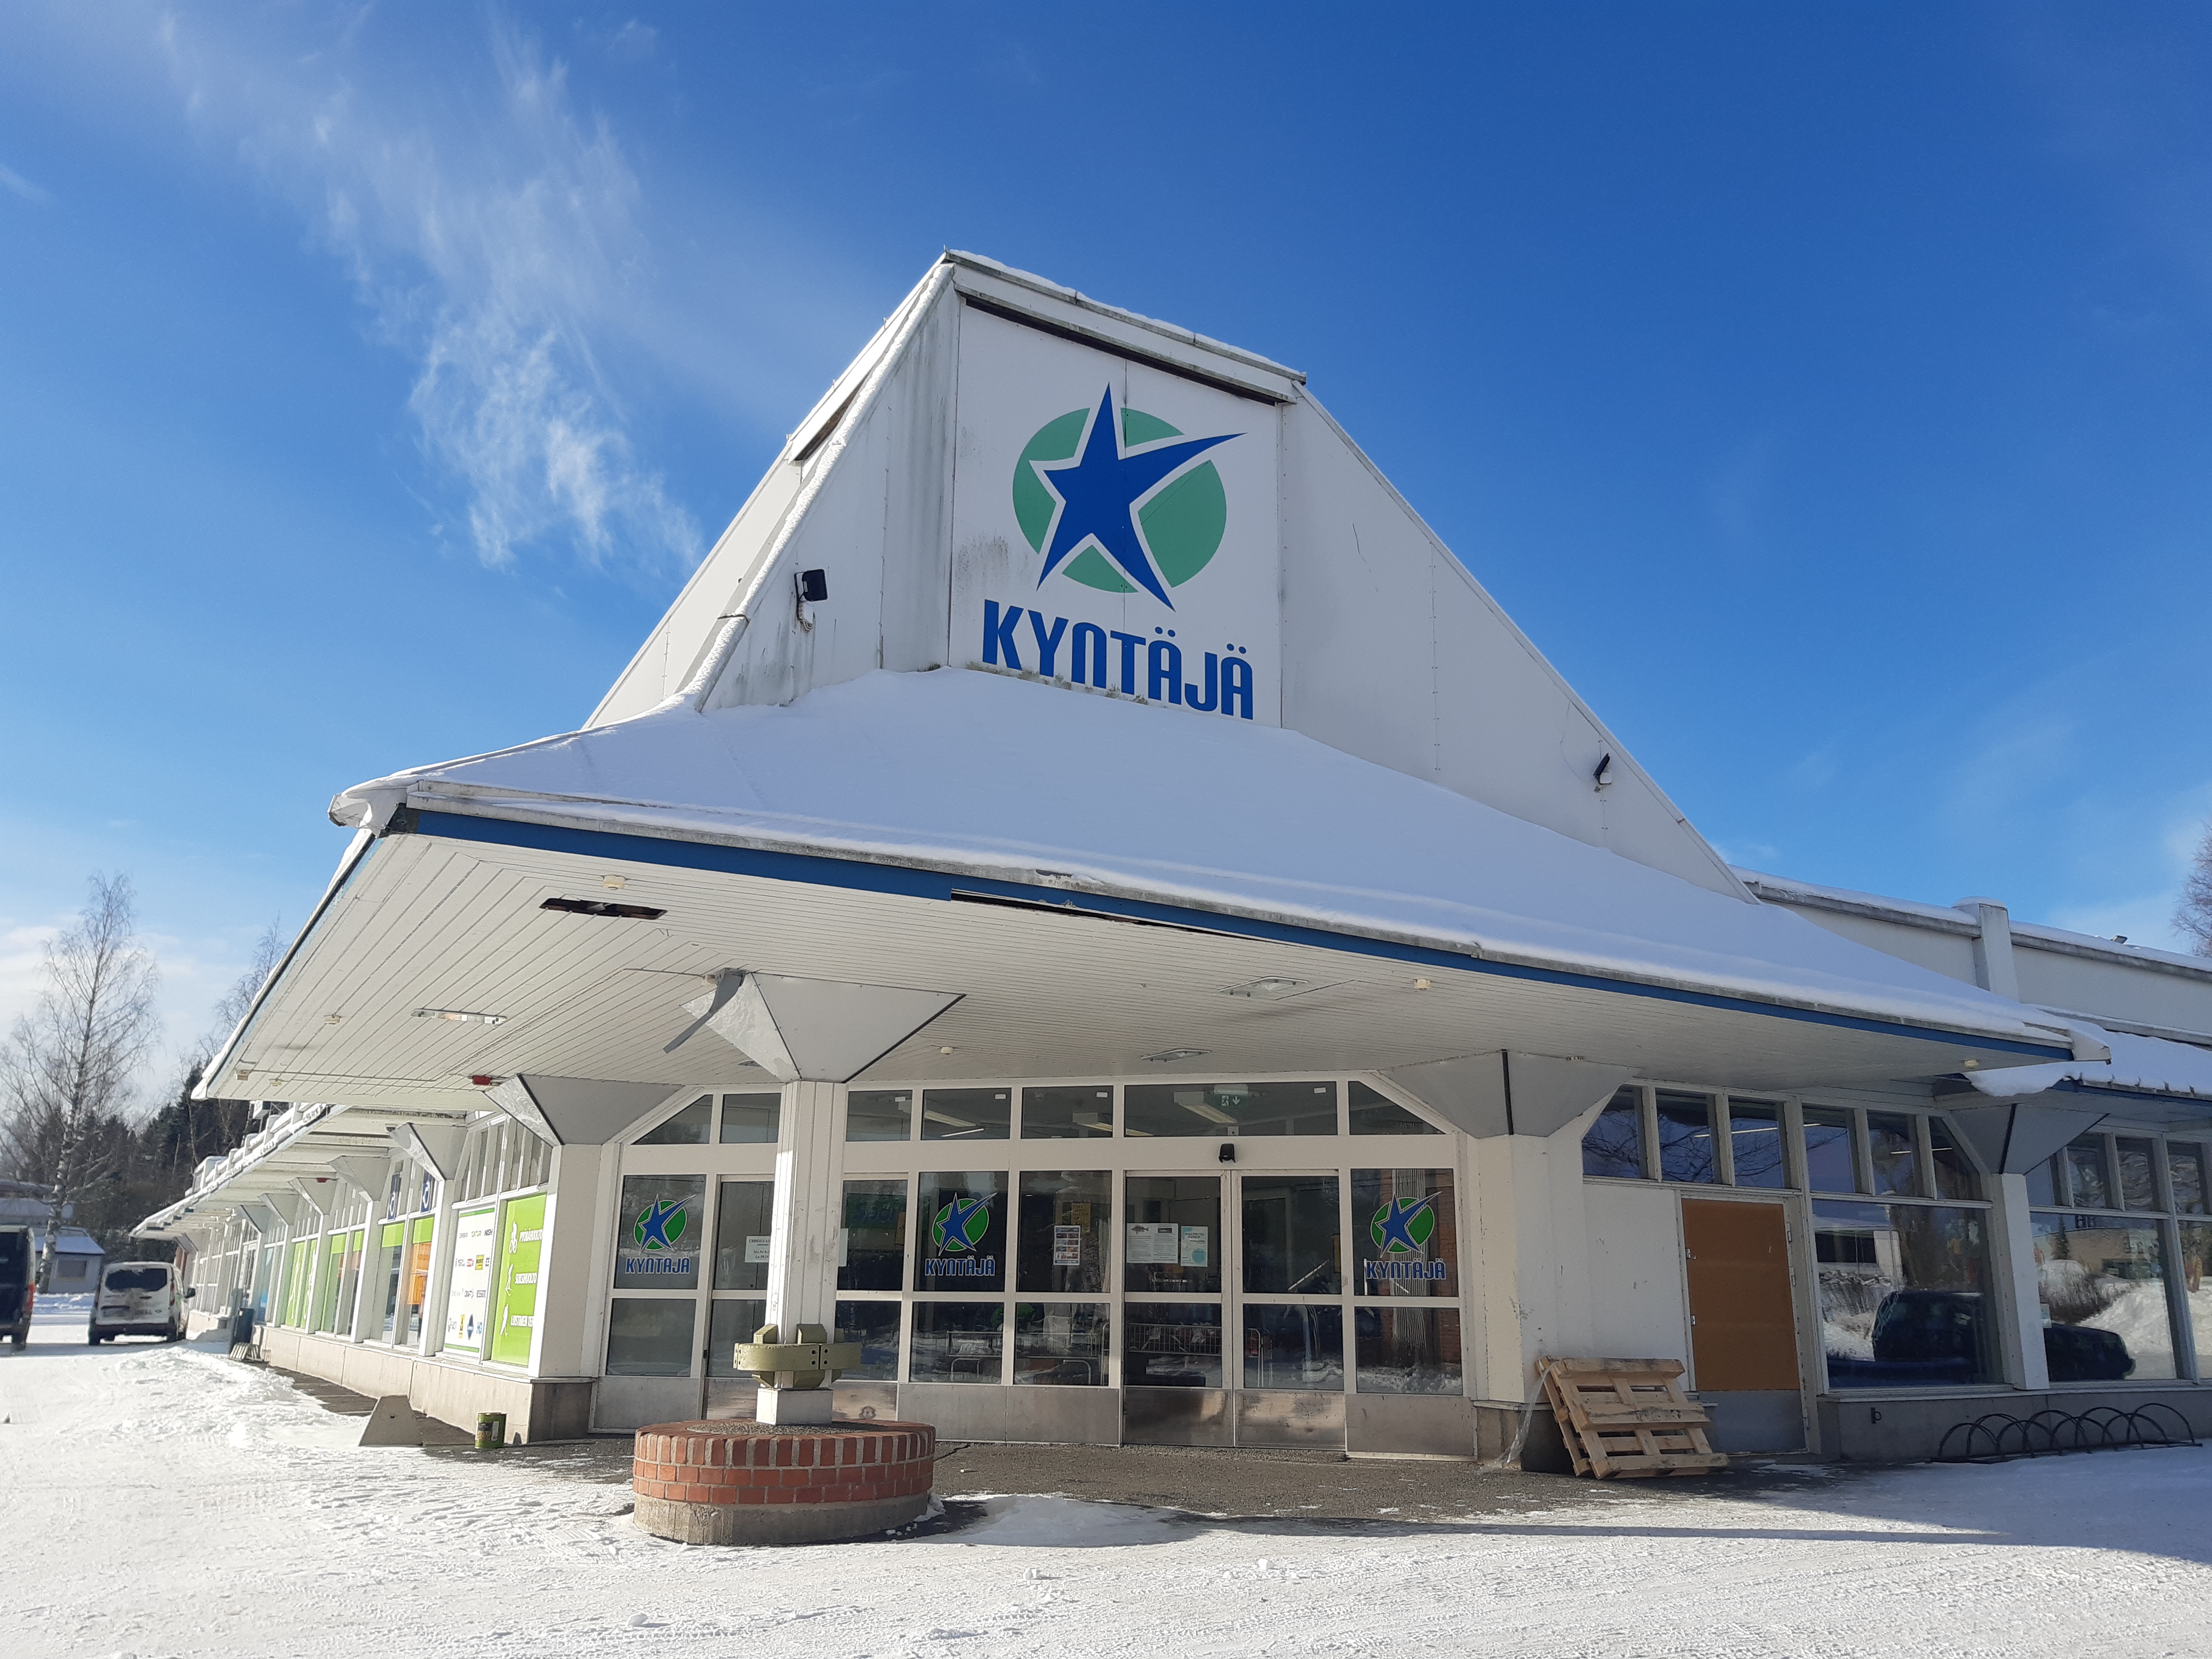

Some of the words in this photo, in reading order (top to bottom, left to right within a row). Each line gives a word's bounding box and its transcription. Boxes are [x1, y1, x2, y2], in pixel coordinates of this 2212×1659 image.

[982, 599, 1253, 720] KYNTÄJÄ
[519, 1227, 543, 1242] PYÖRÄHUOLTO
[625, 1254, 690, 1274] KYNTÄJÄ
[925, 1255, 995, 1276] KYNTÄJÄ
[1366, 1258, 1446, 1280] KYNTÄJÄ
